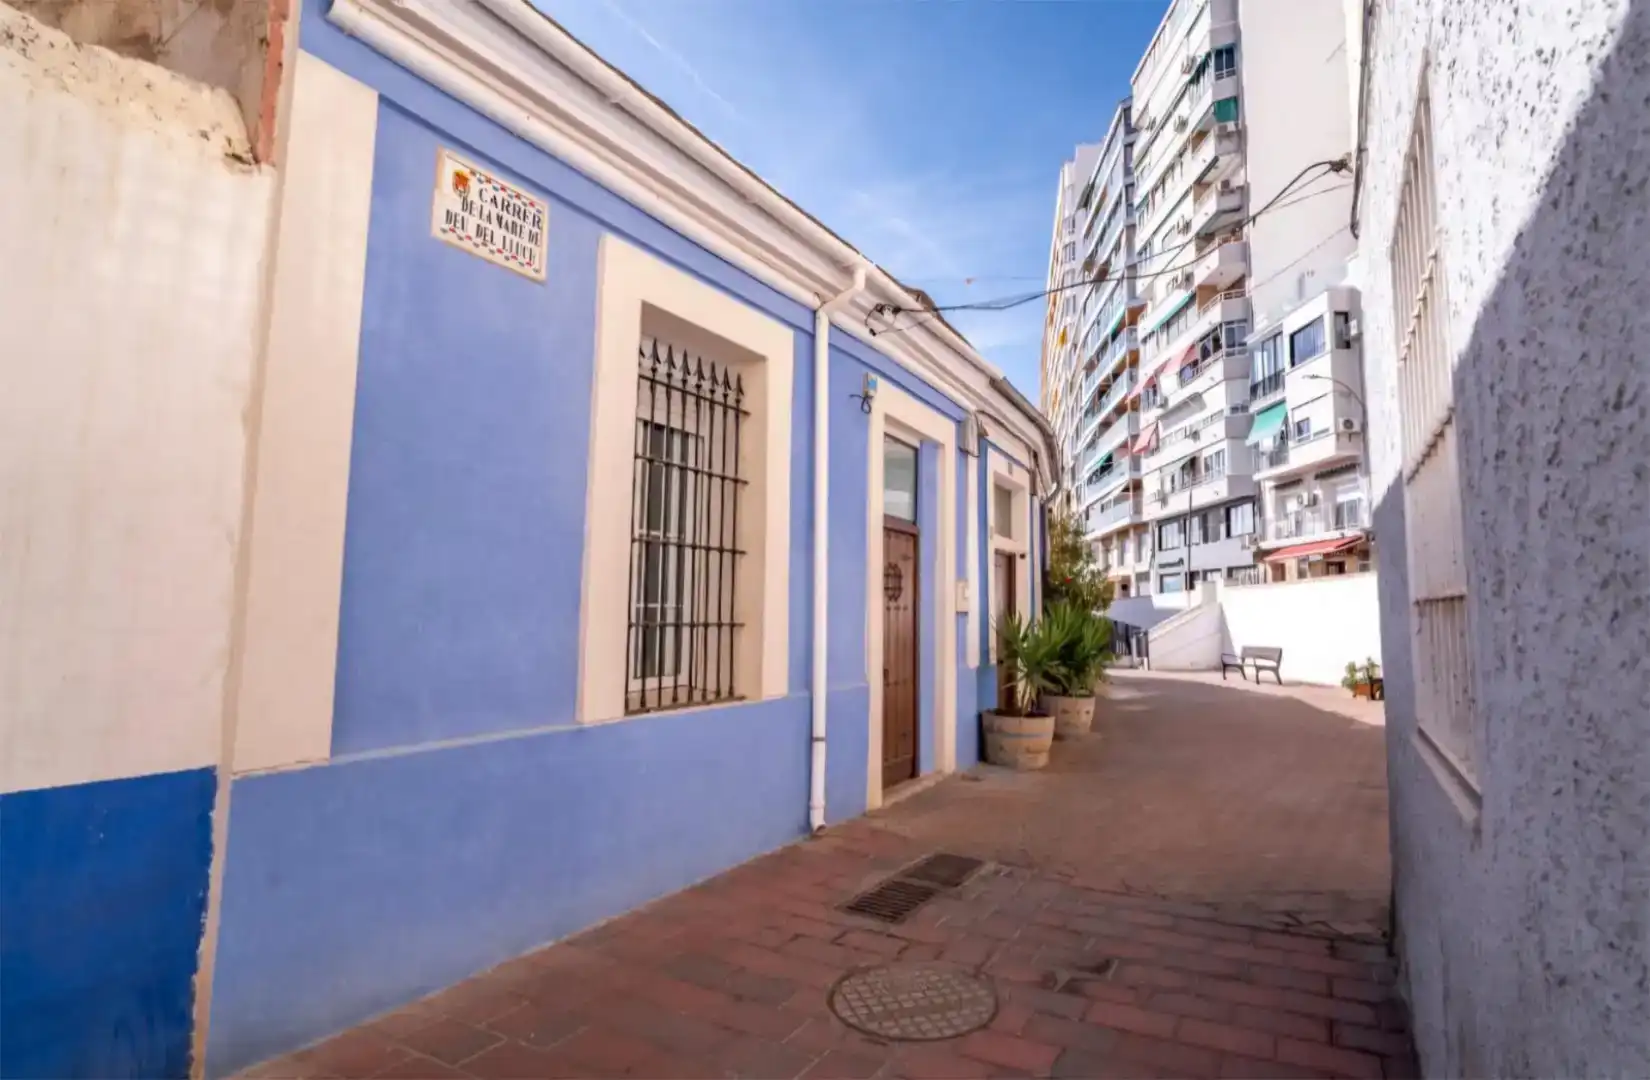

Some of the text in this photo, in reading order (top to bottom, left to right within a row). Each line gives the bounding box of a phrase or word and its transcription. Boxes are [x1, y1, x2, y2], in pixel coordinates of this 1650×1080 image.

[461, 194, 476, 217] DE
[479, 203, 492, 225] LA
[478, 187, 542, 230] CARRER
[476, 223, 497, 246] DEL
